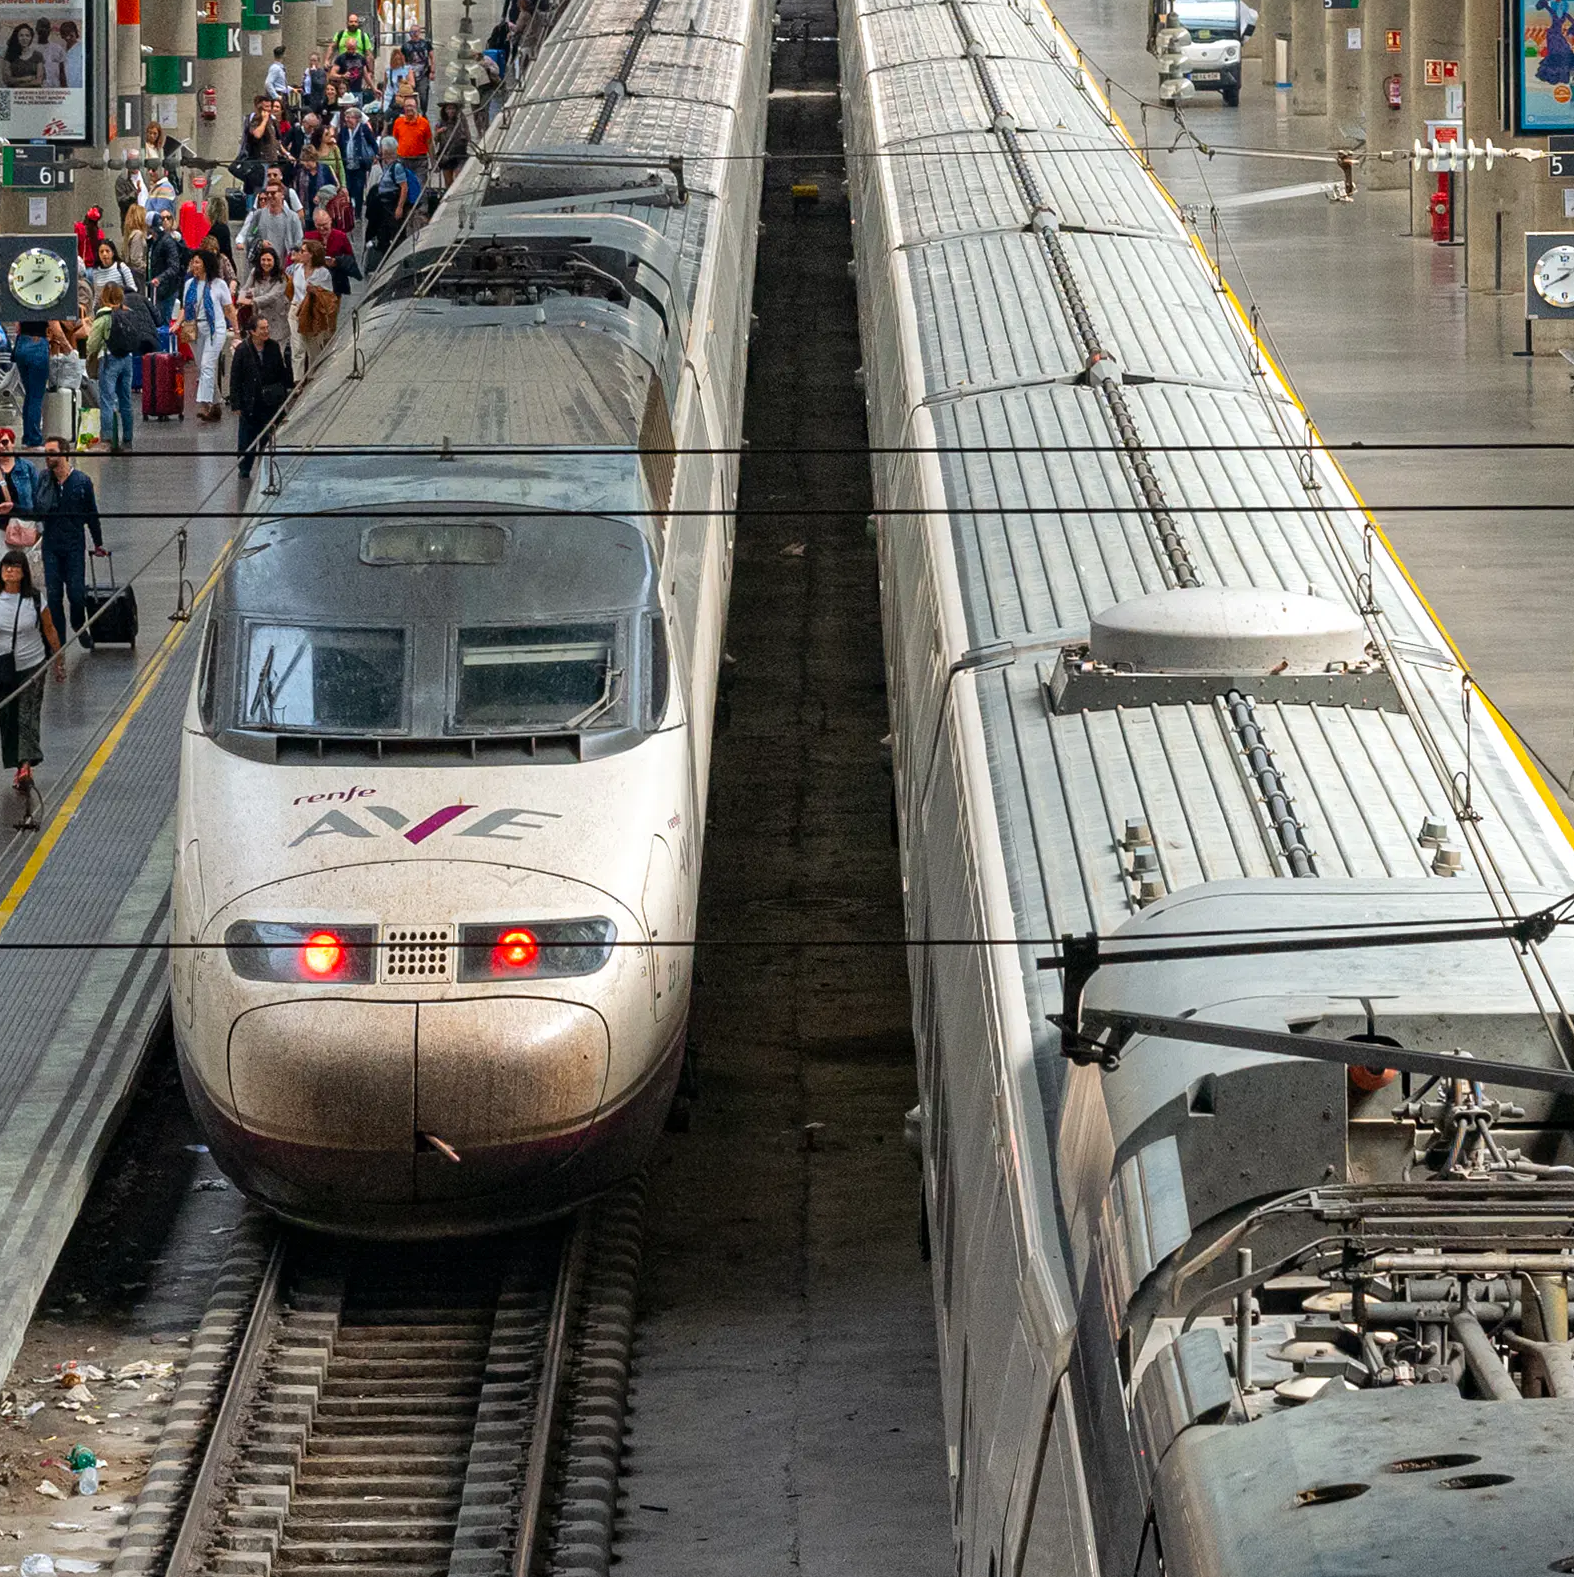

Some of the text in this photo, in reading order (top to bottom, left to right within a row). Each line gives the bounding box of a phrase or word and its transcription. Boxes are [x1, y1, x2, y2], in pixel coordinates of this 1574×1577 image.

[272, 1, 281, 13] 6
[228, 28, 241, 52] K
[182, 62, 192, 87] J
[39, 166, 52, 184] 6
[1552, 156, 1563, 175] 5
[293, 785, 376, 806] renfe
[287, 805, 563, 848] AVE
